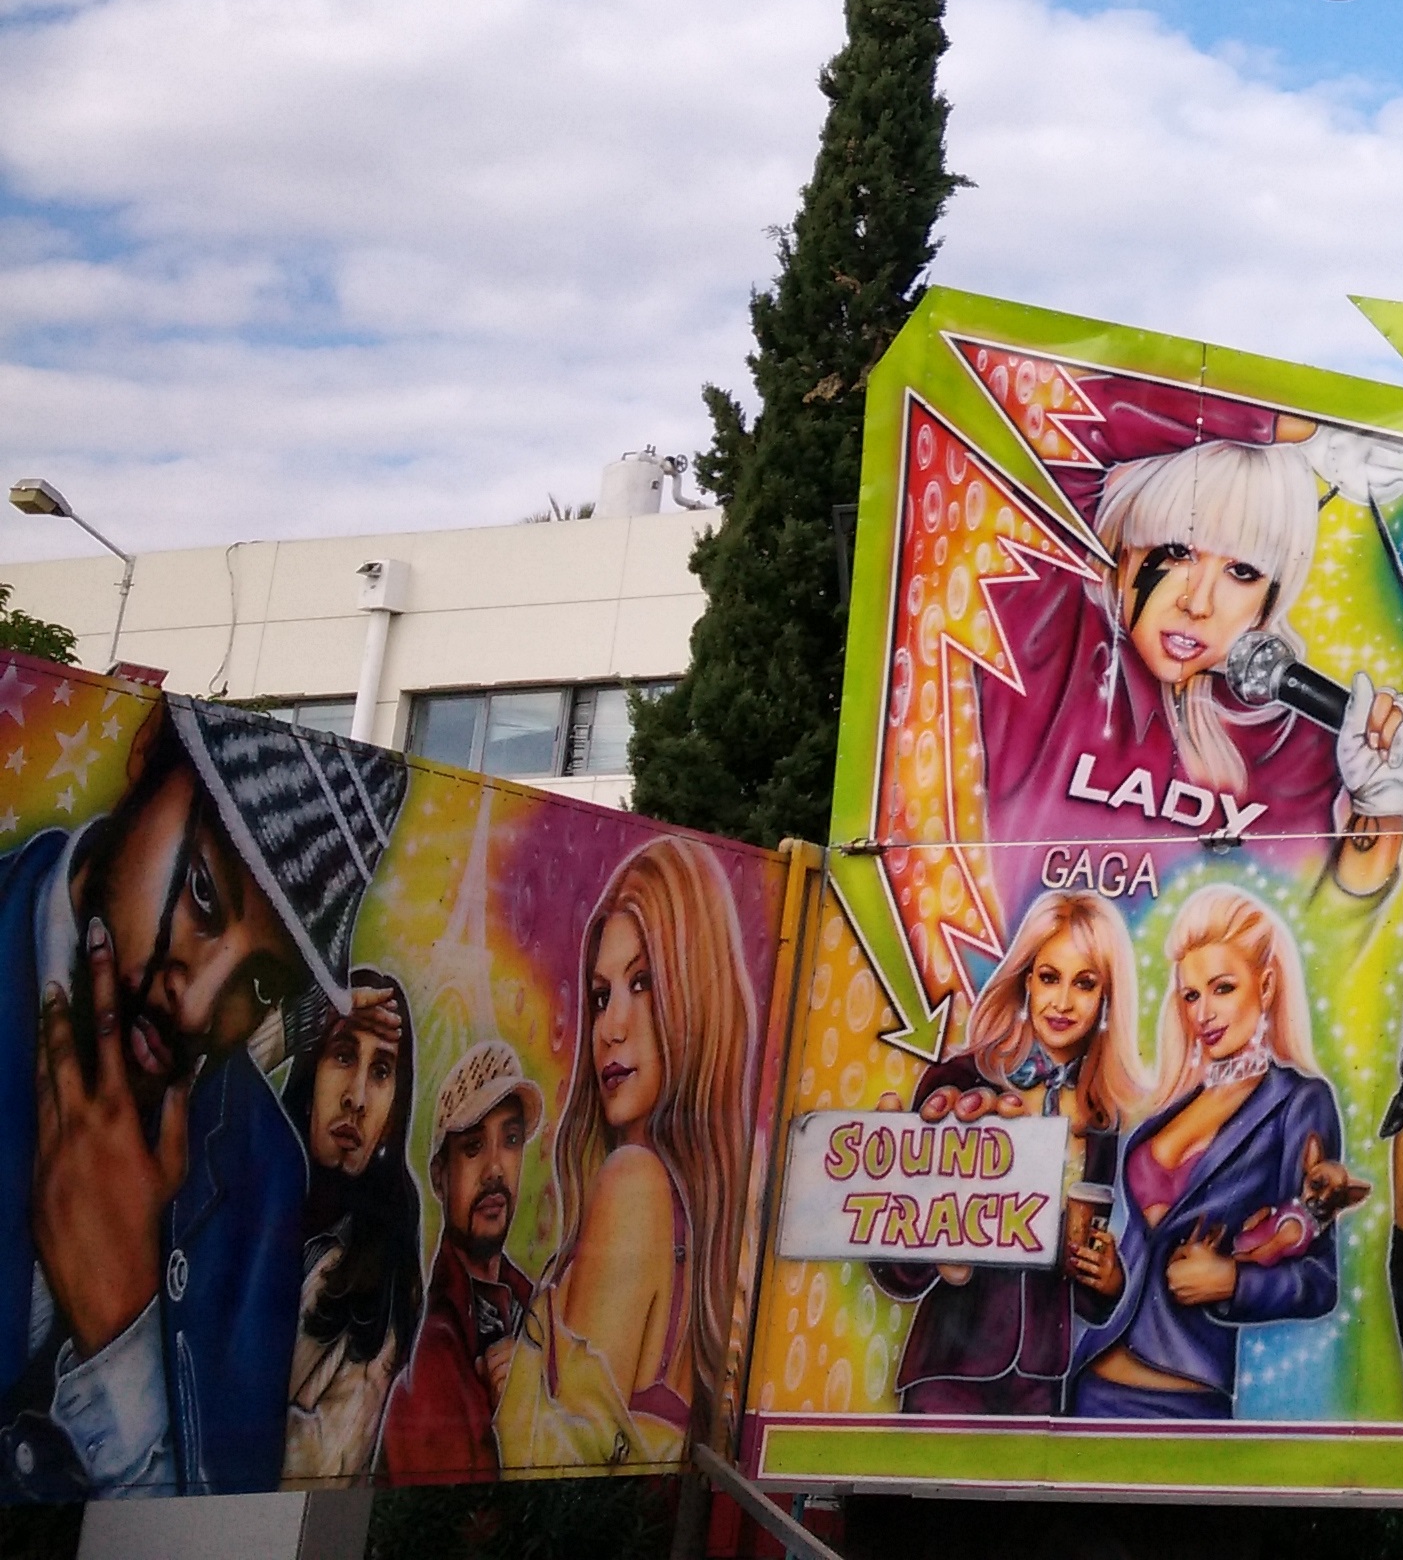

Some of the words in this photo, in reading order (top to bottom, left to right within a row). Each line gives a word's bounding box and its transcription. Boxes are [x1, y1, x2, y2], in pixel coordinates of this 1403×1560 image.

[1069, 752, 1269, 838] LADY
[1040, 845, 1160, 898] GAGA
[824, 1122, 1014, 1180] SOUND
[843, 1192, 1048, 1253] TRACK
